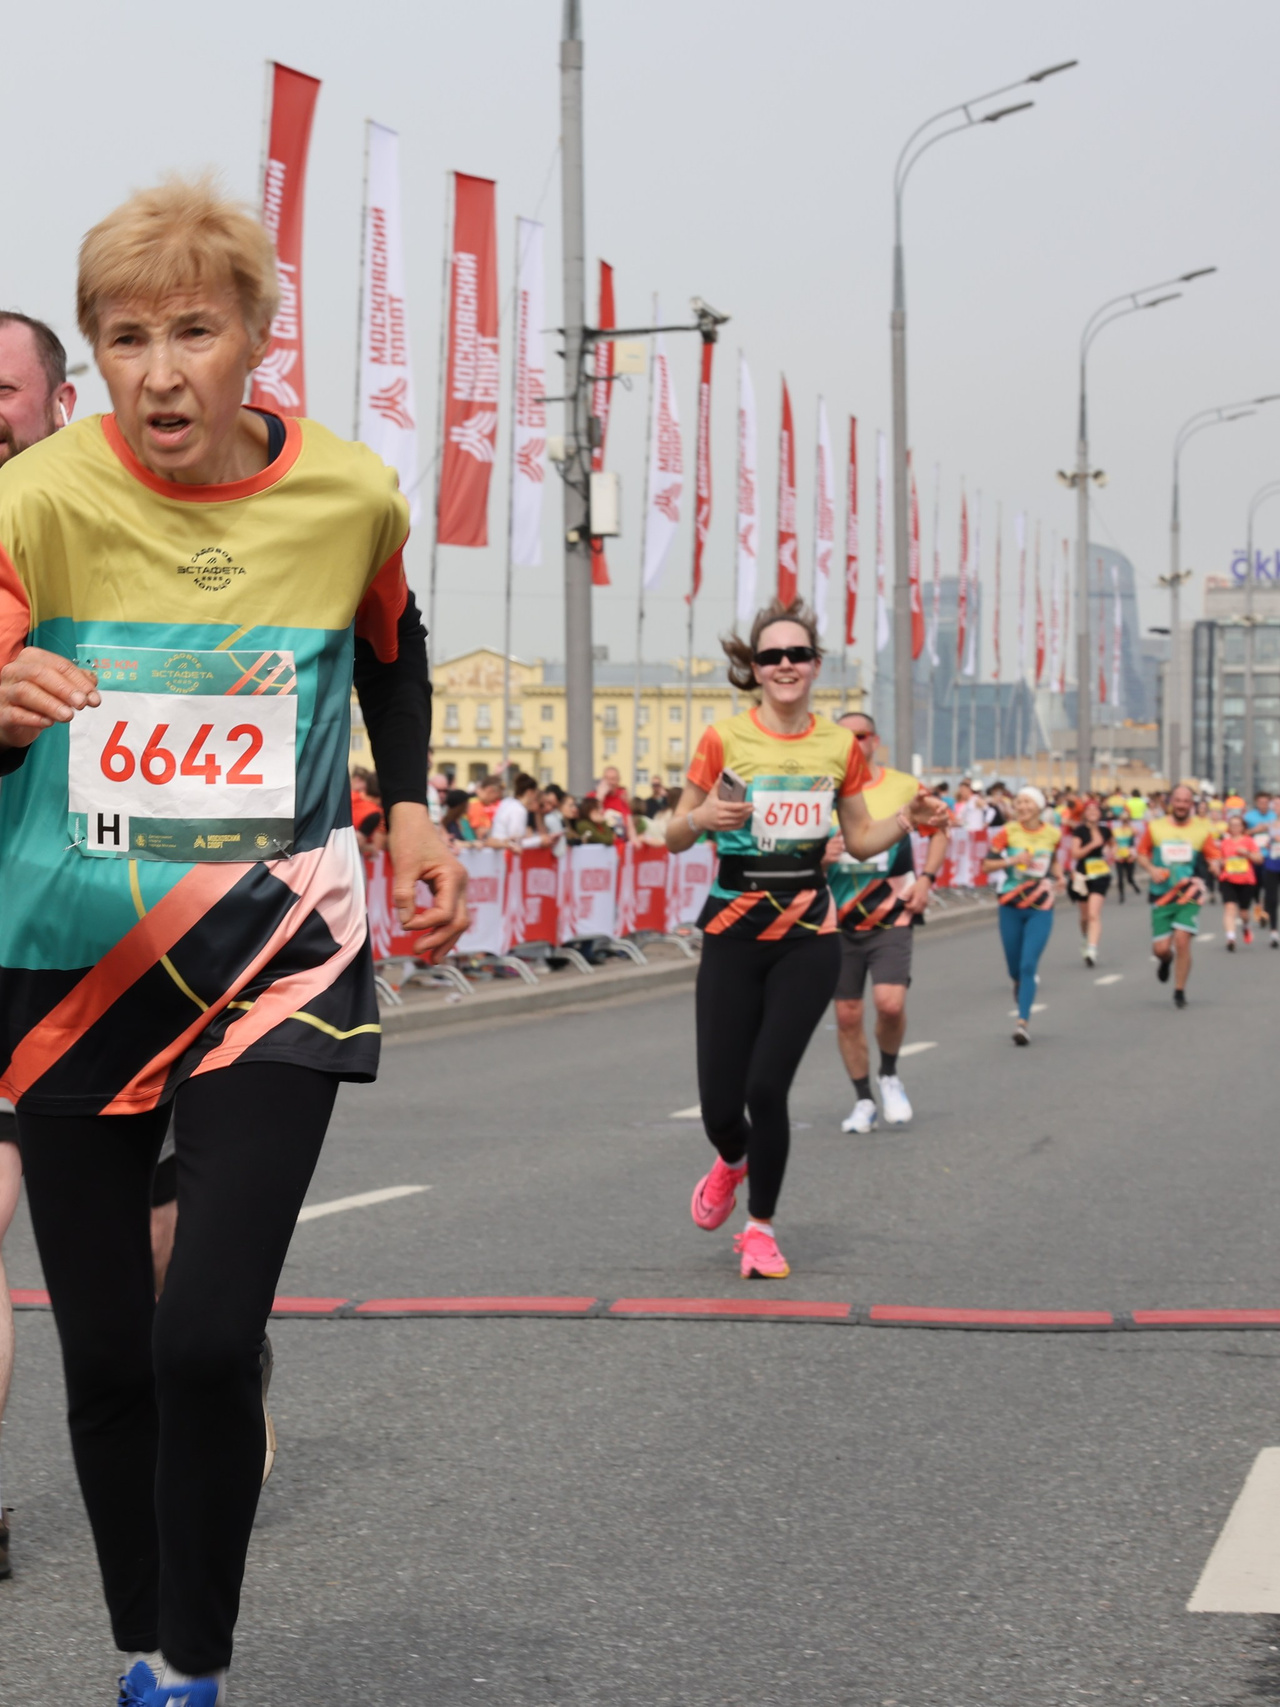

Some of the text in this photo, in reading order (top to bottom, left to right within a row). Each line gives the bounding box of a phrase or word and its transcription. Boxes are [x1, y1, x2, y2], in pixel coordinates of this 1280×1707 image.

[369, 206, 389, 366] МОСКОВСКИЙ
[452, 252, 478, 400] МОСКОВСКИЙ
[474, 334, 499, 402] СПОРТ
[191, 546, 233, 563] САДОВОЕ
[177, 565, 247, 575] ЭСТАФЕТА
[193, 577, 231, 592] КОЛЬЦО
[151, 669, 214, 679] ЭСТАФЕТА
[100, 720, 264, 785] 6642
[764, 802, 821, 826] 6701
